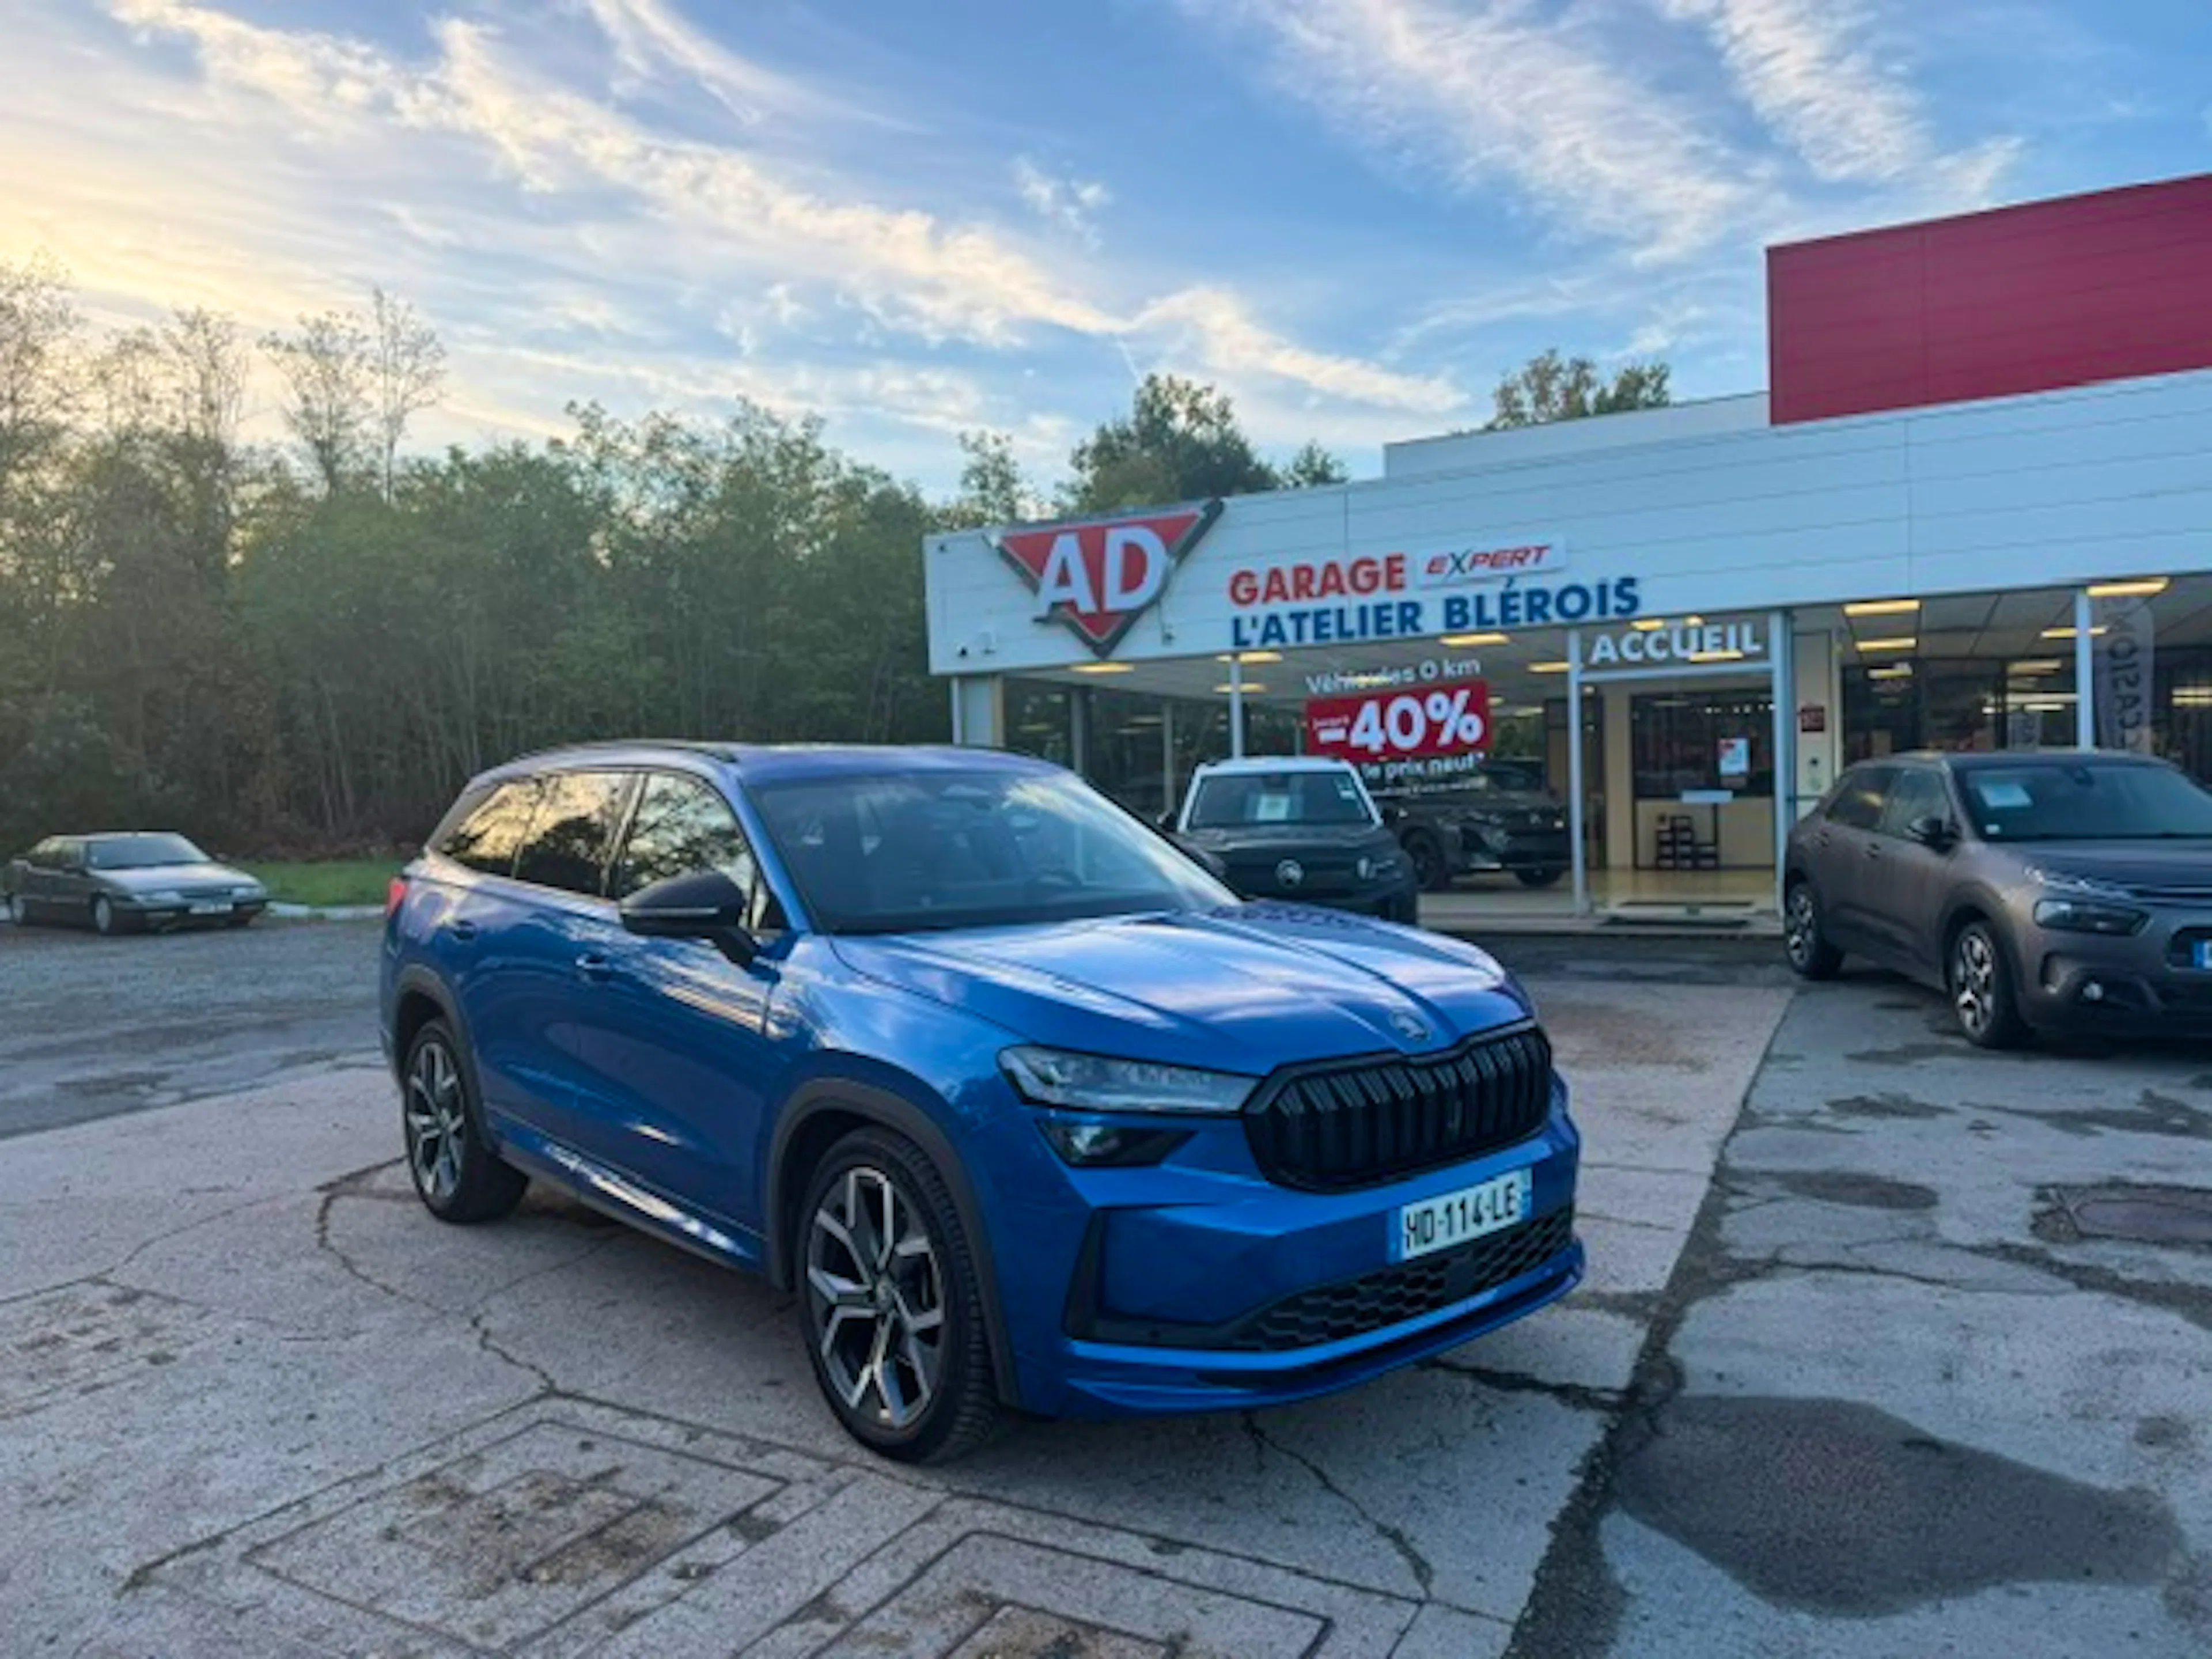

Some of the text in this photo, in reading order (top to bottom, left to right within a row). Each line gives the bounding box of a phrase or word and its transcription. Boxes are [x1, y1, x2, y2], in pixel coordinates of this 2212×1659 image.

[1036, 525, 1169, 613] AD
[1230, 554, 1406, 606] GARAGE
[1232, 577, 1639, 647] L'ATELIER BLÉROIS
[1442, 659, 1481, 677] km
[1590, 622, 1763, 665] ACCUEIL
[1317, 690, 1484, 753] -40%
